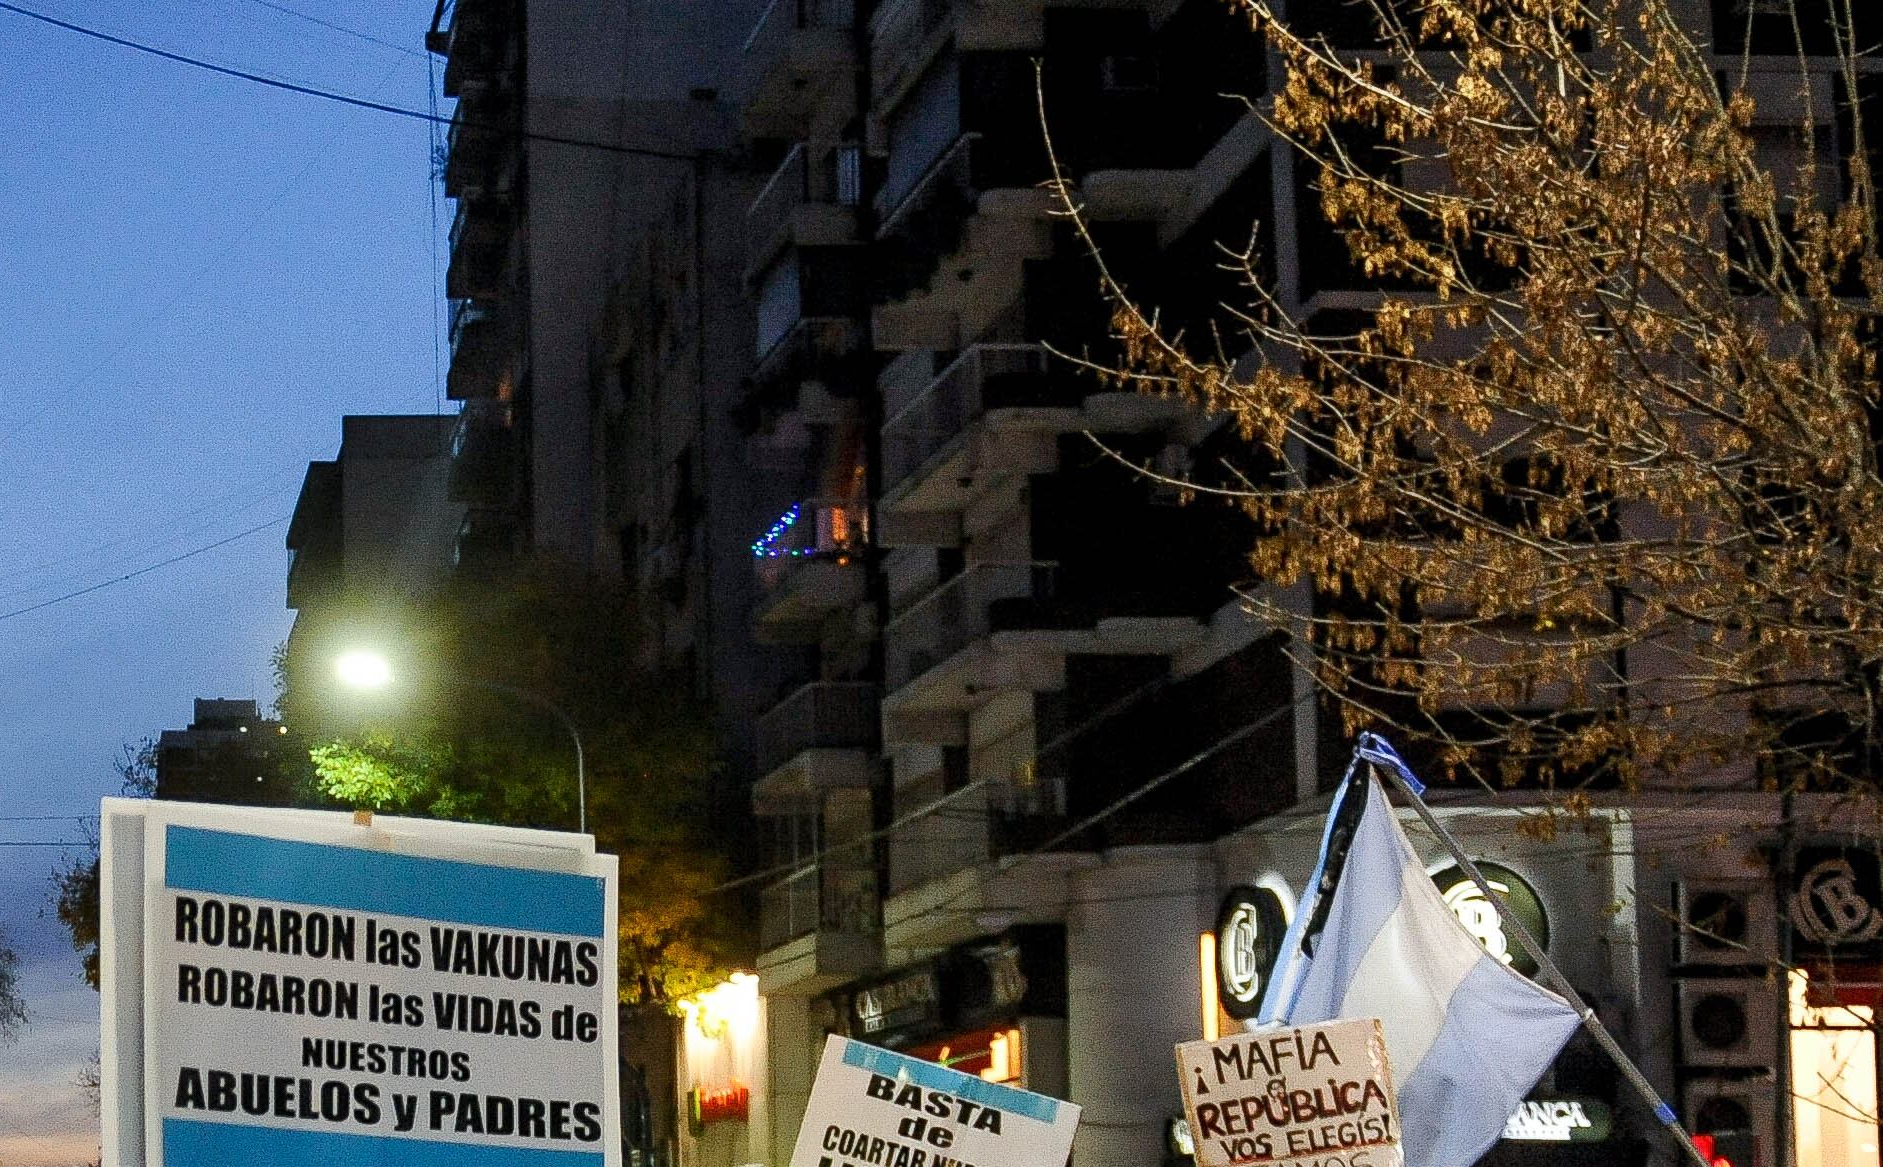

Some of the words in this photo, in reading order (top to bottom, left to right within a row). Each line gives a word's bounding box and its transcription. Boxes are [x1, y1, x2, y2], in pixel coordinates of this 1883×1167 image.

[174, 896, 356, 962] ROBARON
[365, 919, 421, 969] las
[429, 926, 599, 988] VAKUNAS
[177, 964, 358, 1020] ROBARON
[369, 985, 424, 1027] las
[432, 991, 542, 1039] VIDAS
[551, 1004, 598, 1043] de
[301, 1036, 470, 1082] NUESTROS
[174, 1066, 381, 1124] ABUELOS
[392, 1092, 418, 1132] y
[429, 1090, 602, 1143] PADRES
[865, 1073, 1003, 1136] BASTA
[897, 1115, 955, 1149] de
[1220, 1132, 1273, 1163] VOS
